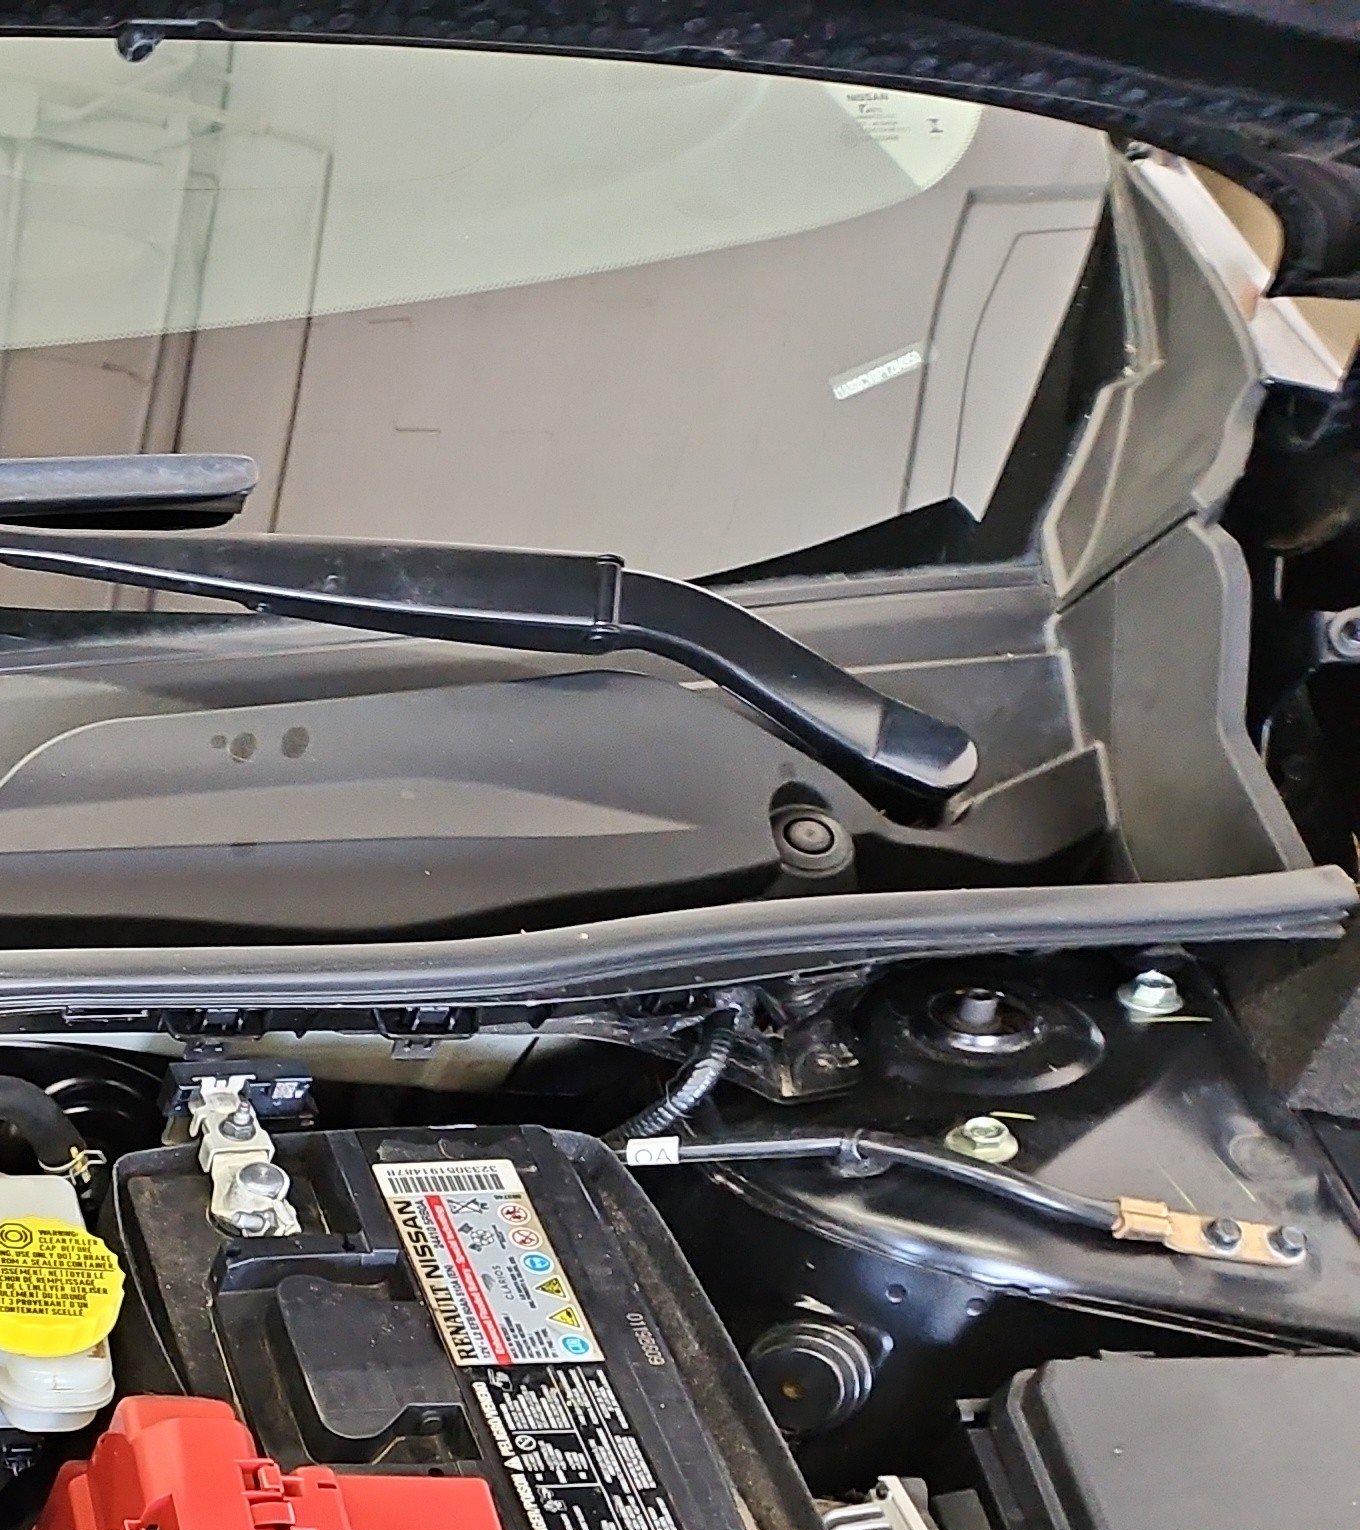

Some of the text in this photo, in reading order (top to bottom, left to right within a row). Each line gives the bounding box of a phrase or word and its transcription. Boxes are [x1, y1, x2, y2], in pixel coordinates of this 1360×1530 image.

[83, 1254, 111, 1262] BRAKE
[31, 1259, 64, 1267] SEALED
[393, 1200, 479, 1360] RENAULT NISSAN
[491, 1264, 515, 1301] CLARIOS
[16, 1299, 66, 1307] PROVENANT
[0, 1306, 49, 1315] CONTENANT
